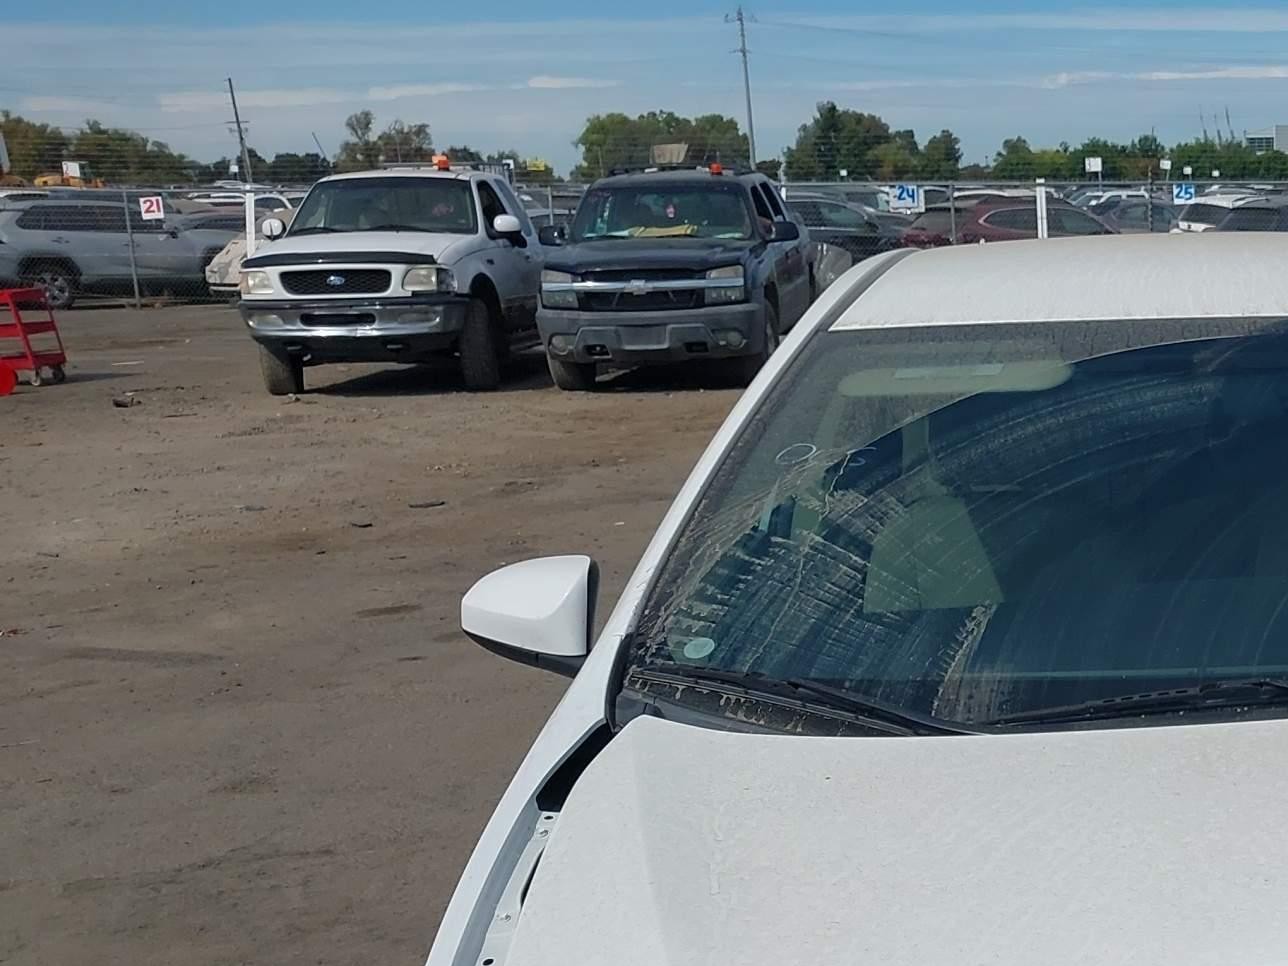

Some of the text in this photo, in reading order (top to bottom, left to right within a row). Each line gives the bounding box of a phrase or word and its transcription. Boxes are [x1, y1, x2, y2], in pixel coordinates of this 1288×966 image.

[897, 184, 916, 204] 24
[1175, 183, 1193, 201] 25
[143, 198, 162, 214] 21
